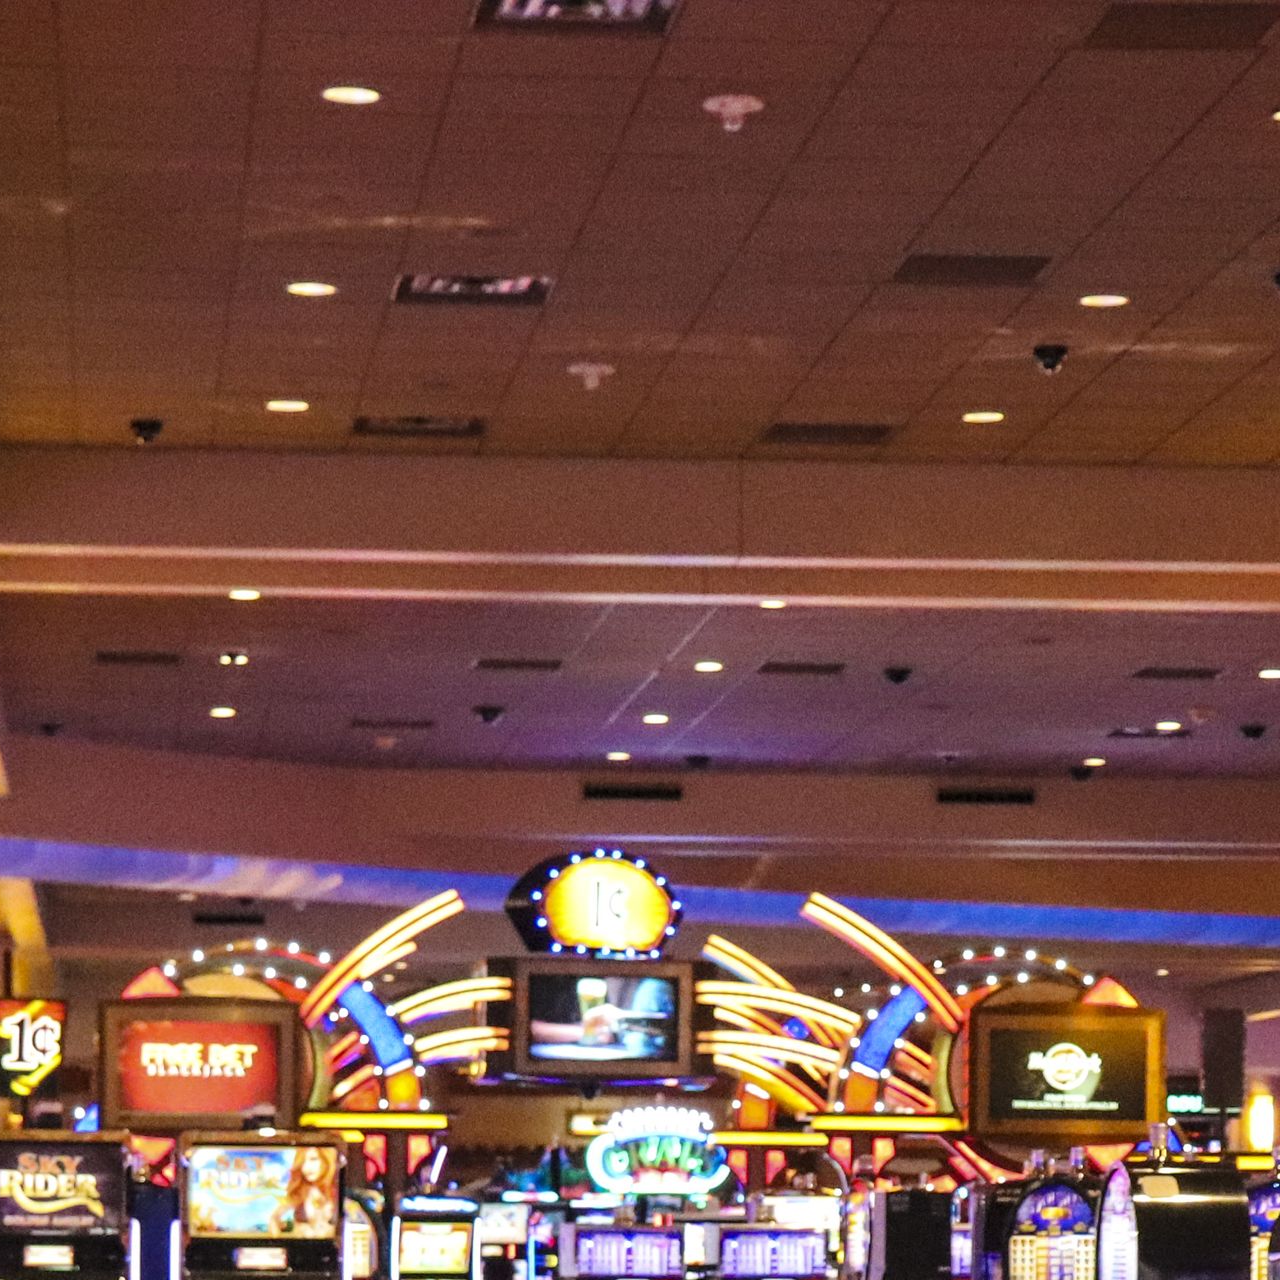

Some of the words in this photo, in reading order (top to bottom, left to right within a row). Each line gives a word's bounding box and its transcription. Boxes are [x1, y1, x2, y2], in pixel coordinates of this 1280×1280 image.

[141, 1043, 204, 1066] FREE
[208, 1043, 258, 1067] BET
[146, 1064, 245, 1077] BLACKJACK
[19, 1154, 83, 1174] SKY
